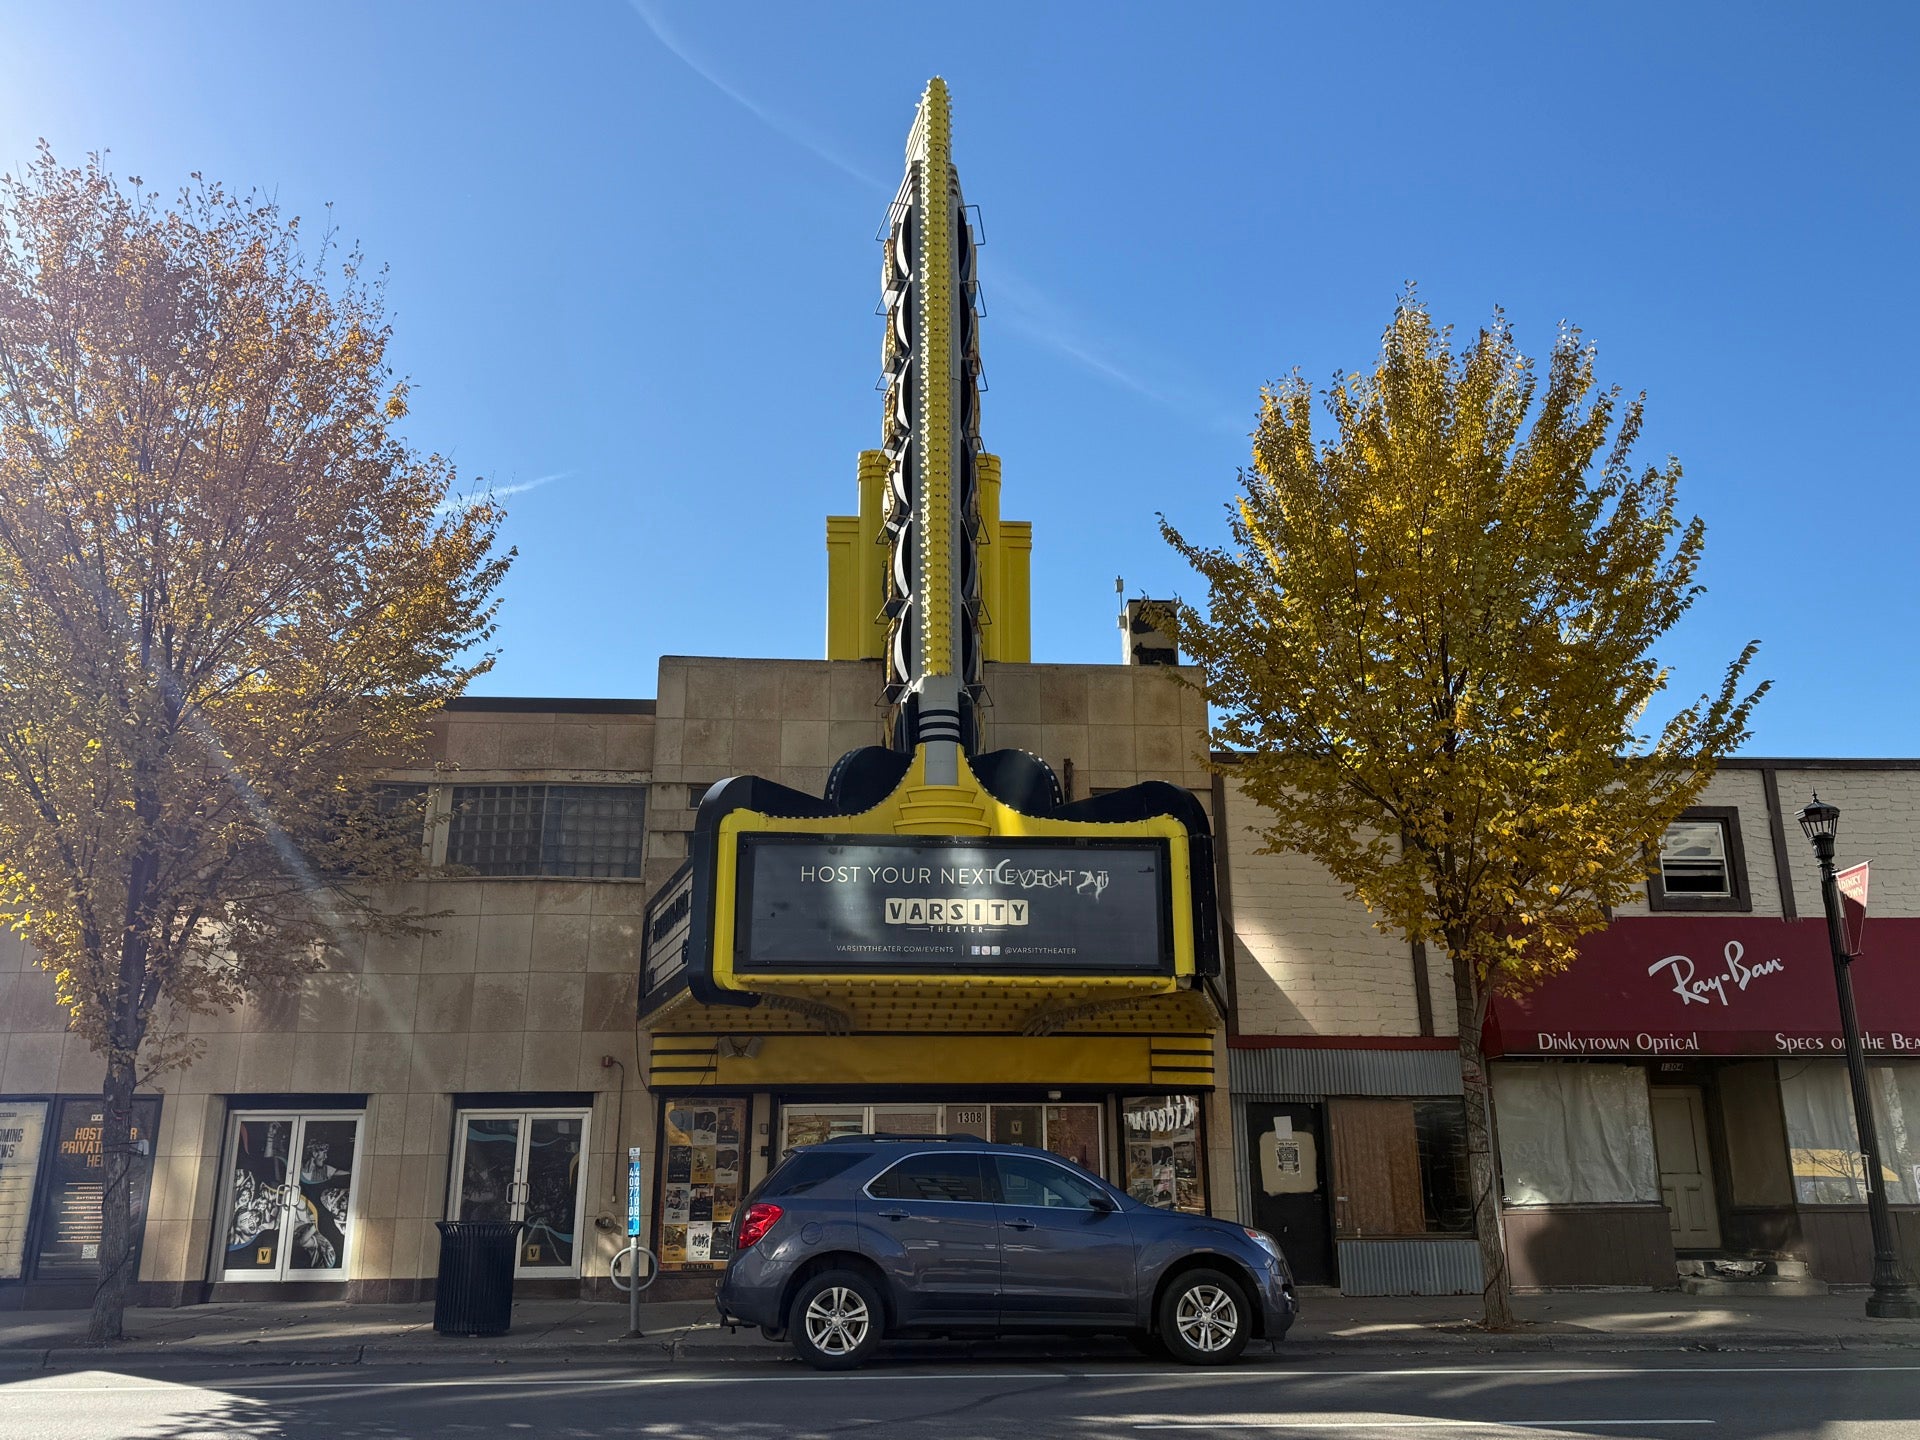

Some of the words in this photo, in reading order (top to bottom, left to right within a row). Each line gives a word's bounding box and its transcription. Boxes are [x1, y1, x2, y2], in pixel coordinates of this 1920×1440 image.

[801, 866, 861, 883] HOST
[869, 867, 932, 885] YOUR
[940, 868, 997, 885] NEXT
[1005, 869, 1075, 887] EVENT
[1083, 870, 1108, 886] AT
[889, 902, 1026, 922] VARSITY
[929, 925, 984, 934] THEATER
[836, 945, 955, 954] VARSITYTHEATER.COM/EVENTS
[1004, 946, 1077, 955] @VARSITYTHEATER
[1537, 1032, 1630, 1054] Dinkytown
[1636, 1032, 1700, 1054] Optical
[1775, 1032, 1825, 1054] Specs
[957, 1111, 982, 1124] 1308
[75, 1127, 104, 1140] HOST
[61, 1141, 104, 1154] PRIVAT
[86, 1155, 104, 1168] HE
[260, 1250, 269, 1261] V
